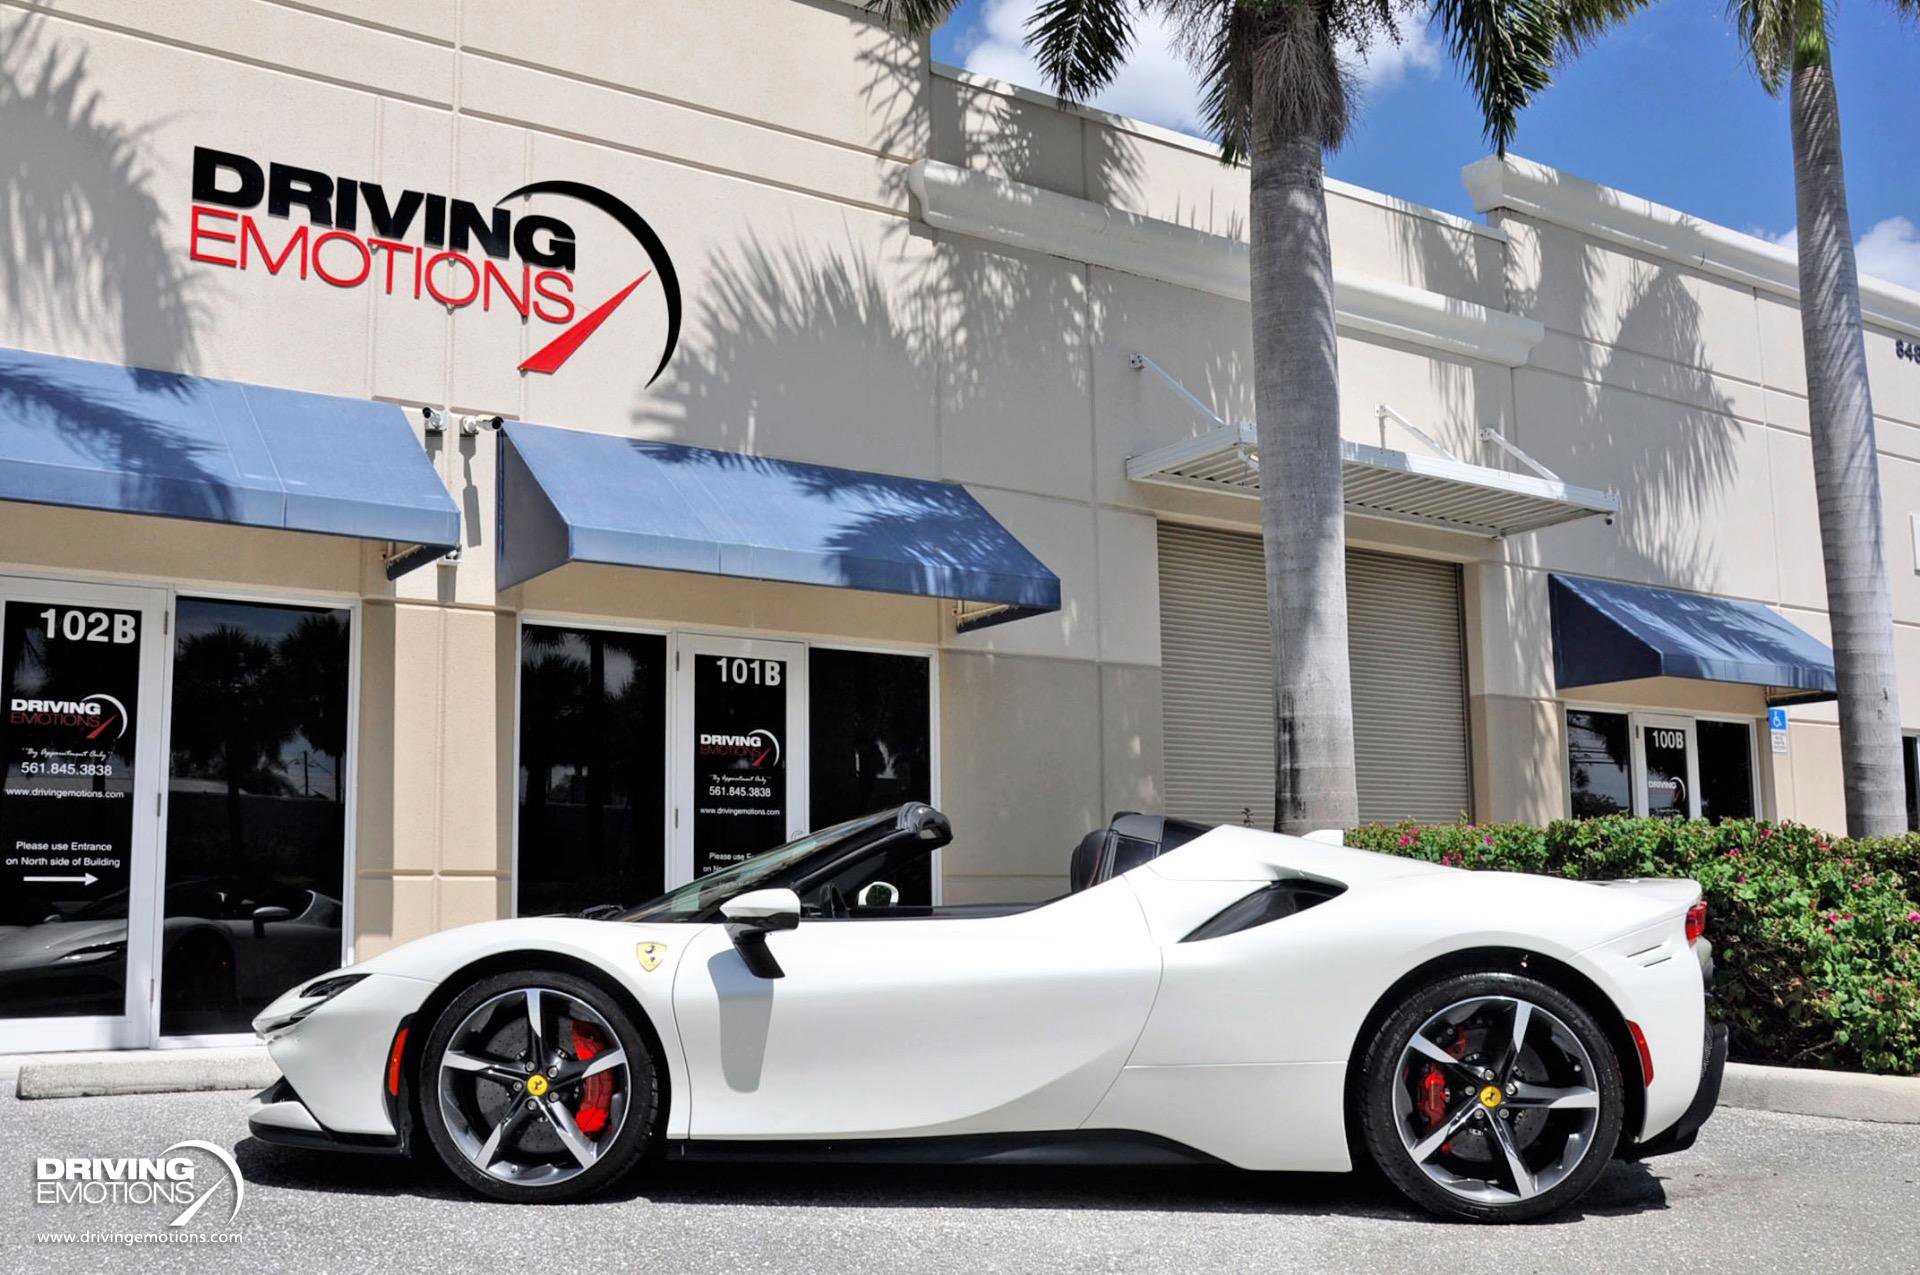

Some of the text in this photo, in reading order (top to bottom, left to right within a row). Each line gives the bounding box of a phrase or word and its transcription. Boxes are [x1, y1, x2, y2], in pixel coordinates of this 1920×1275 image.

[194, 146, 576, 272] DRIVING
[190, 206, 575, 324] EMOTIONS
[40, 608, 136, 644] 102B
[716, 657, 781, 686] 101B
[11, 699, 101, 715] DRIVING
[10, 712, 101, 728] EMOTIONS
[700, 734, 762, 747] DRIVING
[1652, 730, 1684, 749] 100B
[21, 762, 112, 776] 561.845.3838
[5, 788, 124, 798] www.drivingemotions.com
[709, 786, 771, 797] 561.845.3838
[700, 808, 780, 816] www.drivingemotions.com
[16, 841, 112, 851] Please use Entrance
[21, 857, 48, 866] North
[50, 857, 70, 866] side
[72, 857, 82, 866] of
[83, 858, 120, 868] Building
[709, 852, 731, 860] Please
